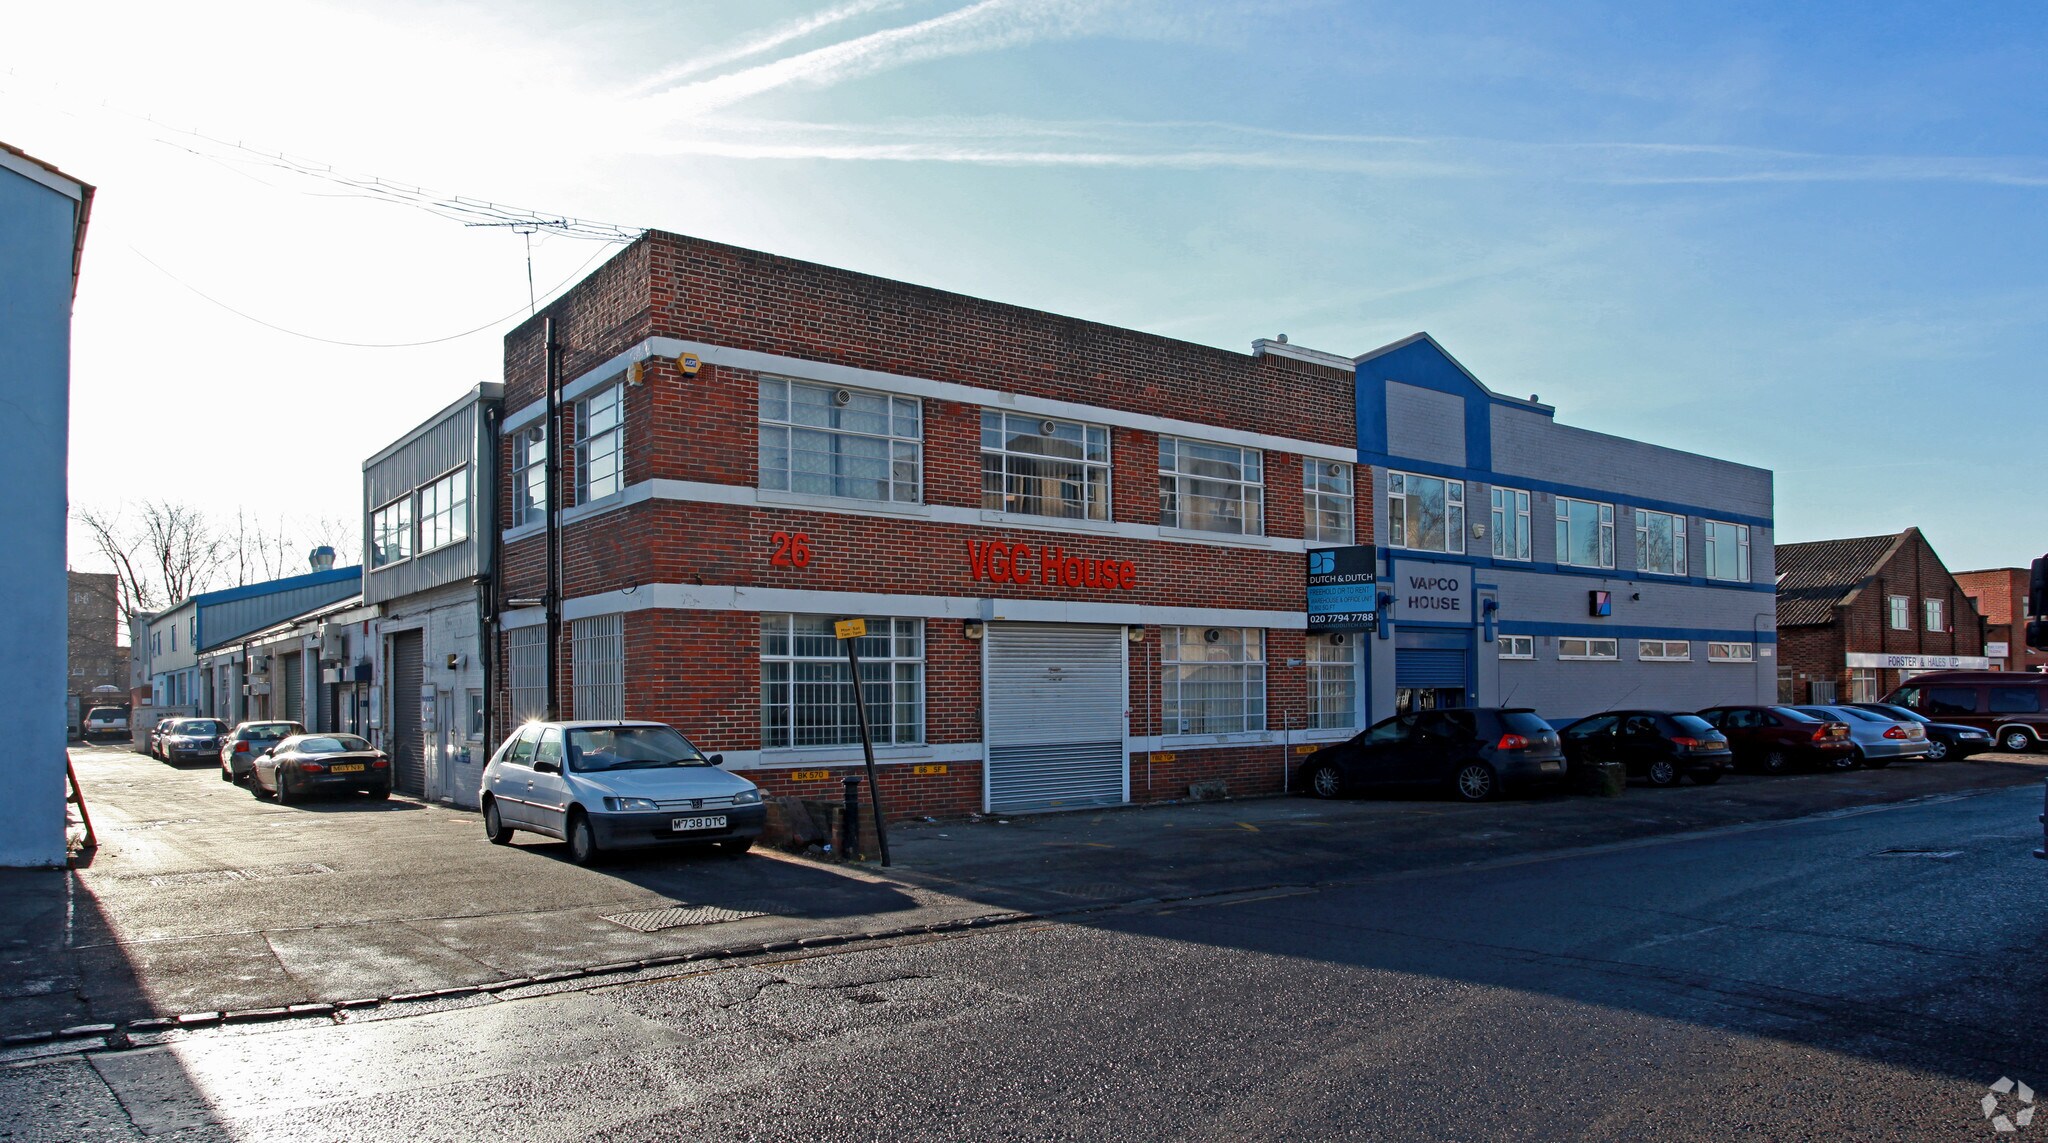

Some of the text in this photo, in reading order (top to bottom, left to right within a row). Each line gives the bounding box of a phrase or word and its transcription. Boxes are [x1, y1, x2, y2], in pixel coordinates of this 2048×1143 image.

[770, 531, 810, 568] 26
[966, 539, 1136, 590] VGC House
[1310, 575, 1336, 584] DUTCH
[1345, 573, 1373, 582] DUTCH
[1409, 576, 1459, 591] VAPCO
[1310, 587, 1336, 595] FREEHOLD
[1337, 587, 1346, 595] OR
[1408, 596, 1460, 611] HOUSE
[1310, 613, 1374, 623] 020 7794 7788
[1888, 656, 1960, 667] FORSTER & HALES LTD
[809, 771, 824, 779] 570
[674, 817, 725, 829] M738 DTC
